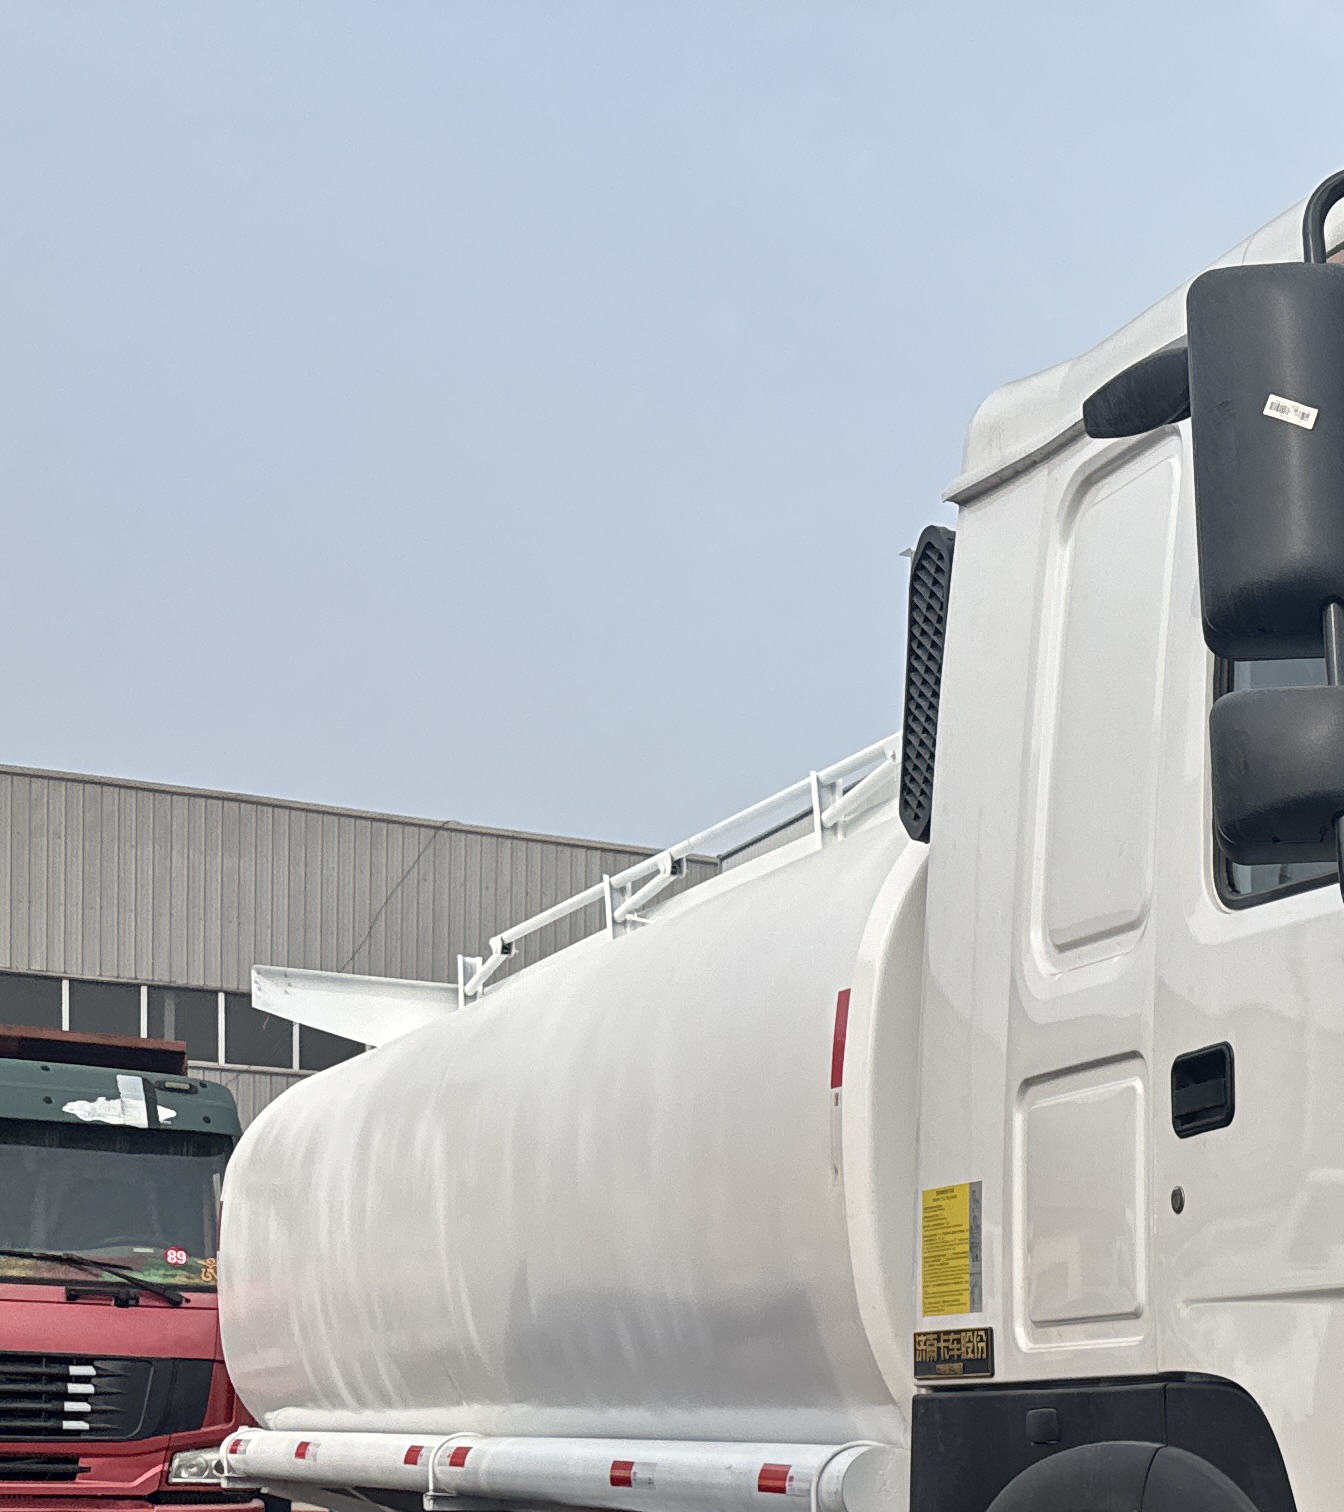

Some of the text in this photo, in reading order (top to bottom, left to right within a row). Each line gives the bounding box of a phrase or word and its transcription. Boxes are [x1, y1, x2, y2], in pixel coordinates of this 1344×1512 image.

[166, 1249, 188, 1265] 89
[915, 1330, 988, 1362] 济南卡车股份
